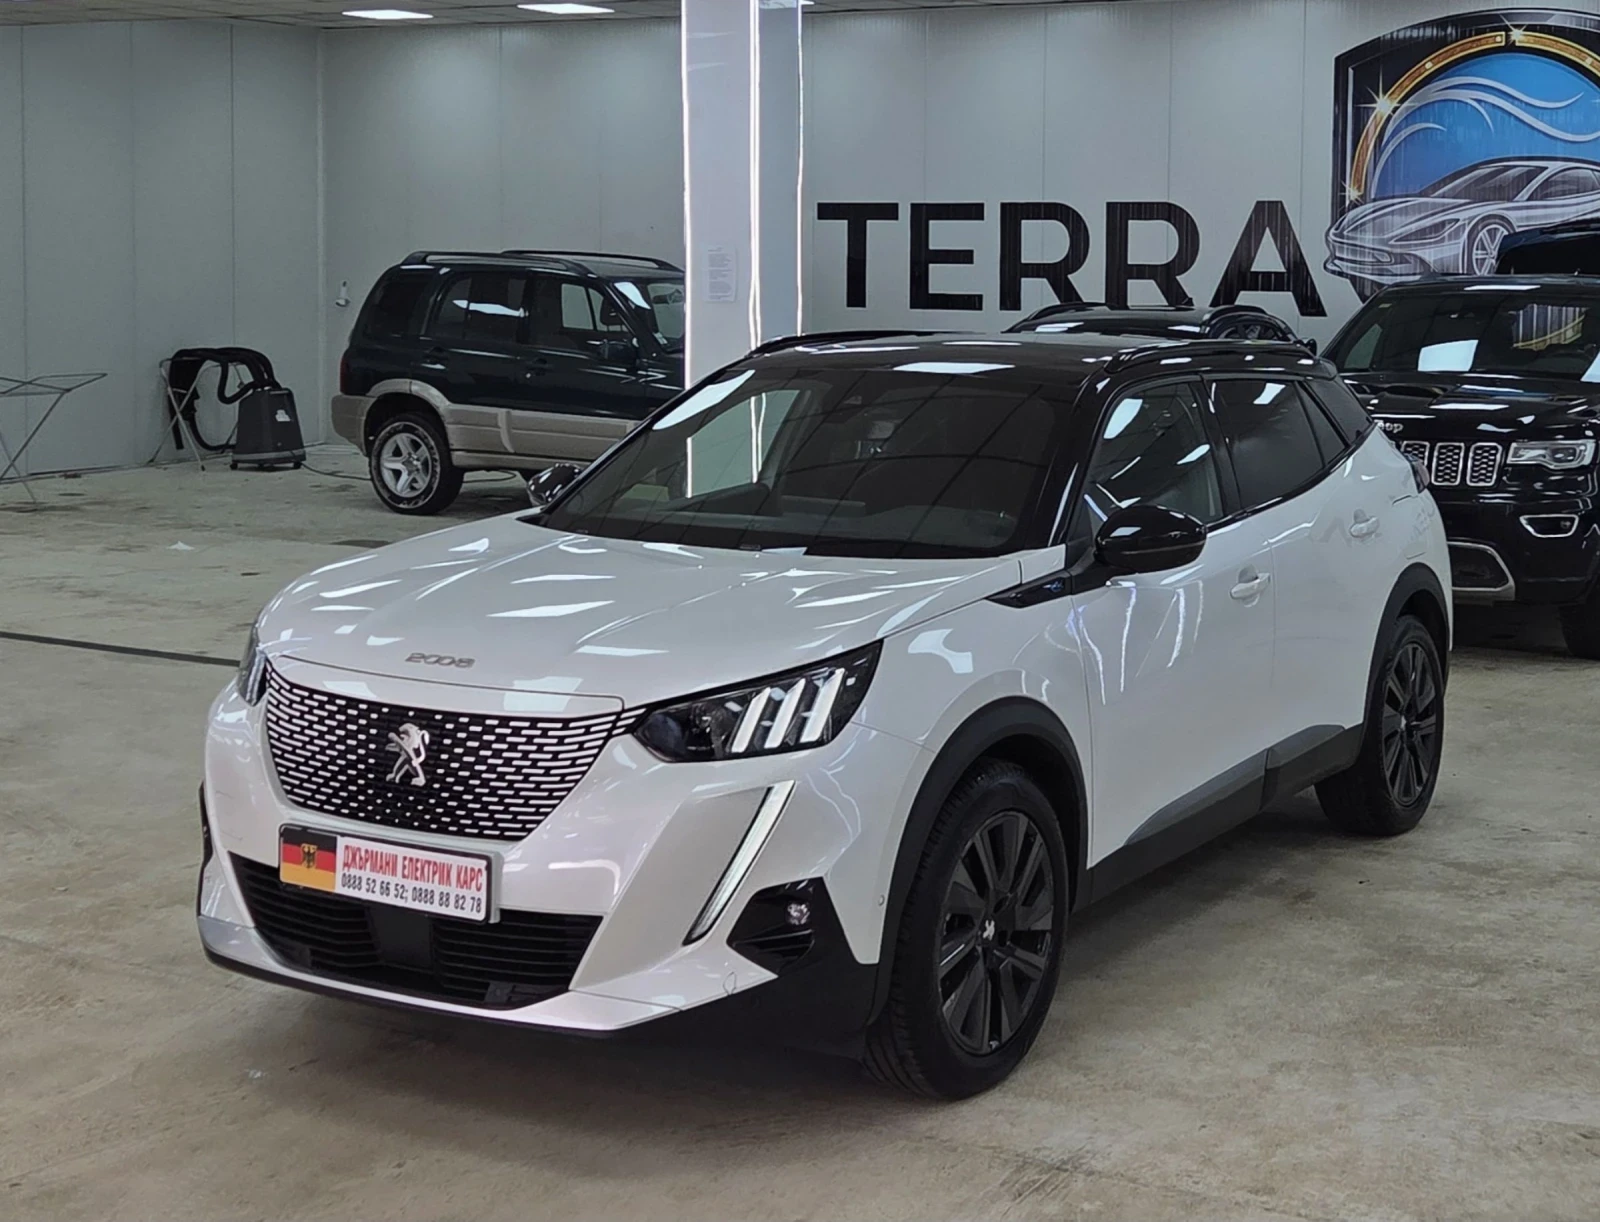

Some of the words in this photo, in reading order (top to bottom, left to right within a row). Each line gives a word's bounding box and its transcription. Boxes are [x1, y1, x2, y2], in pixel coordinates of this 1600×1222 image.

[817, 200, 1327, 317] TERRA
[405, 652, 475, 669] 2008
[343, 845, 398, 877] ДЖЪРМАНИ
[402, 856, 452, 887] ЕЛЕКТРИК
[456, 865, 482, 892] КАРС
[341, 873, 362, 890] 0888
[365, 877, 377, 894] 52
[379, 880, 391, 898] 66
[412, 887, 434, 905] 0888
[438, 891, 450, 909] 88
[454, 893, 467, 911] 82
[470, 896, 482, 914] 78
